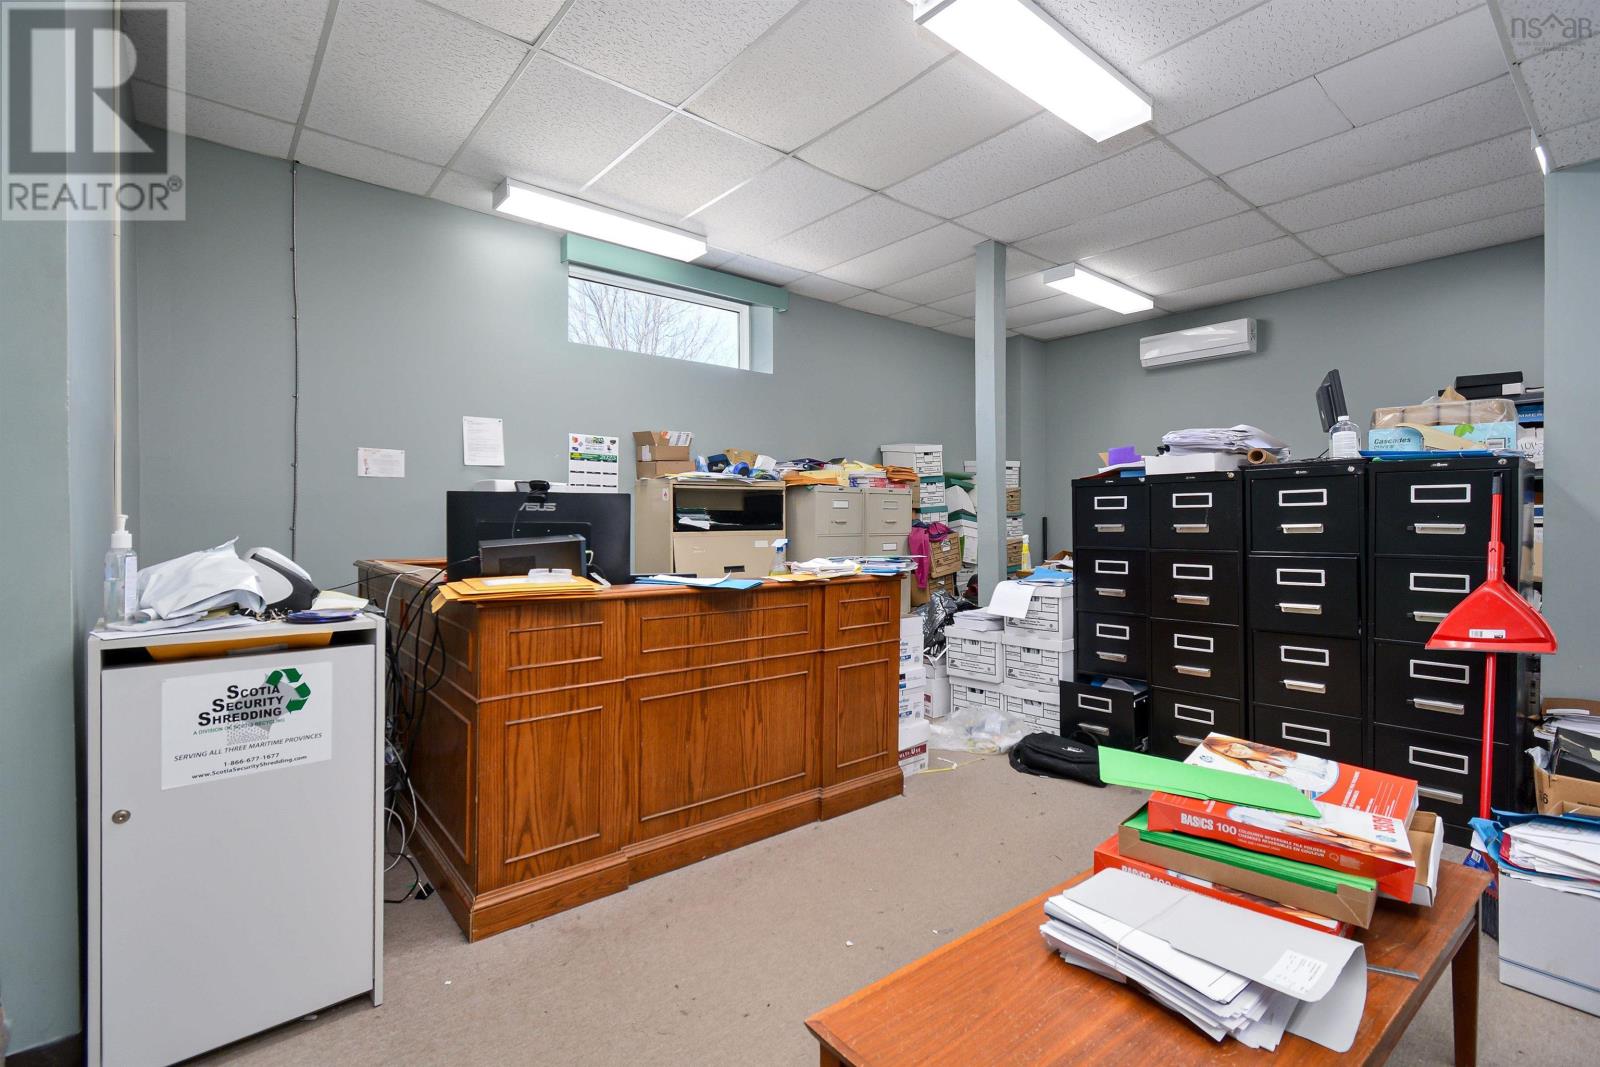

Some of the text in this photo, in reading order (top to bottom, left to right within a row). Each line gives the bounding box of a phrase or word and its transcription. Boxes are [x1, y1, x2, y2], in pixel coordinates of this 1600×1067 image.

[1374, 437, 1411, 445] Cascades
[519, 502, 557, 511] ASUS
[212, 695, 284, 712] SECURITY
[198, 707, 282, 726] SHREDDING
[199, 727, 223, 735] DIVISION
[174, 751, 207, 762] SERVING
[225, 745, 246, 753] THREE
[248, 738, 283, 749] MARITIME
[284, 732, 322, 744] PROVINCES
[191, 755, 307, 779] www.ScotiaSecurityShredding.com
[224, 753, 280, 767] 1-866-677-1677
[1180, 813, 1237, 835] BASICS 100
